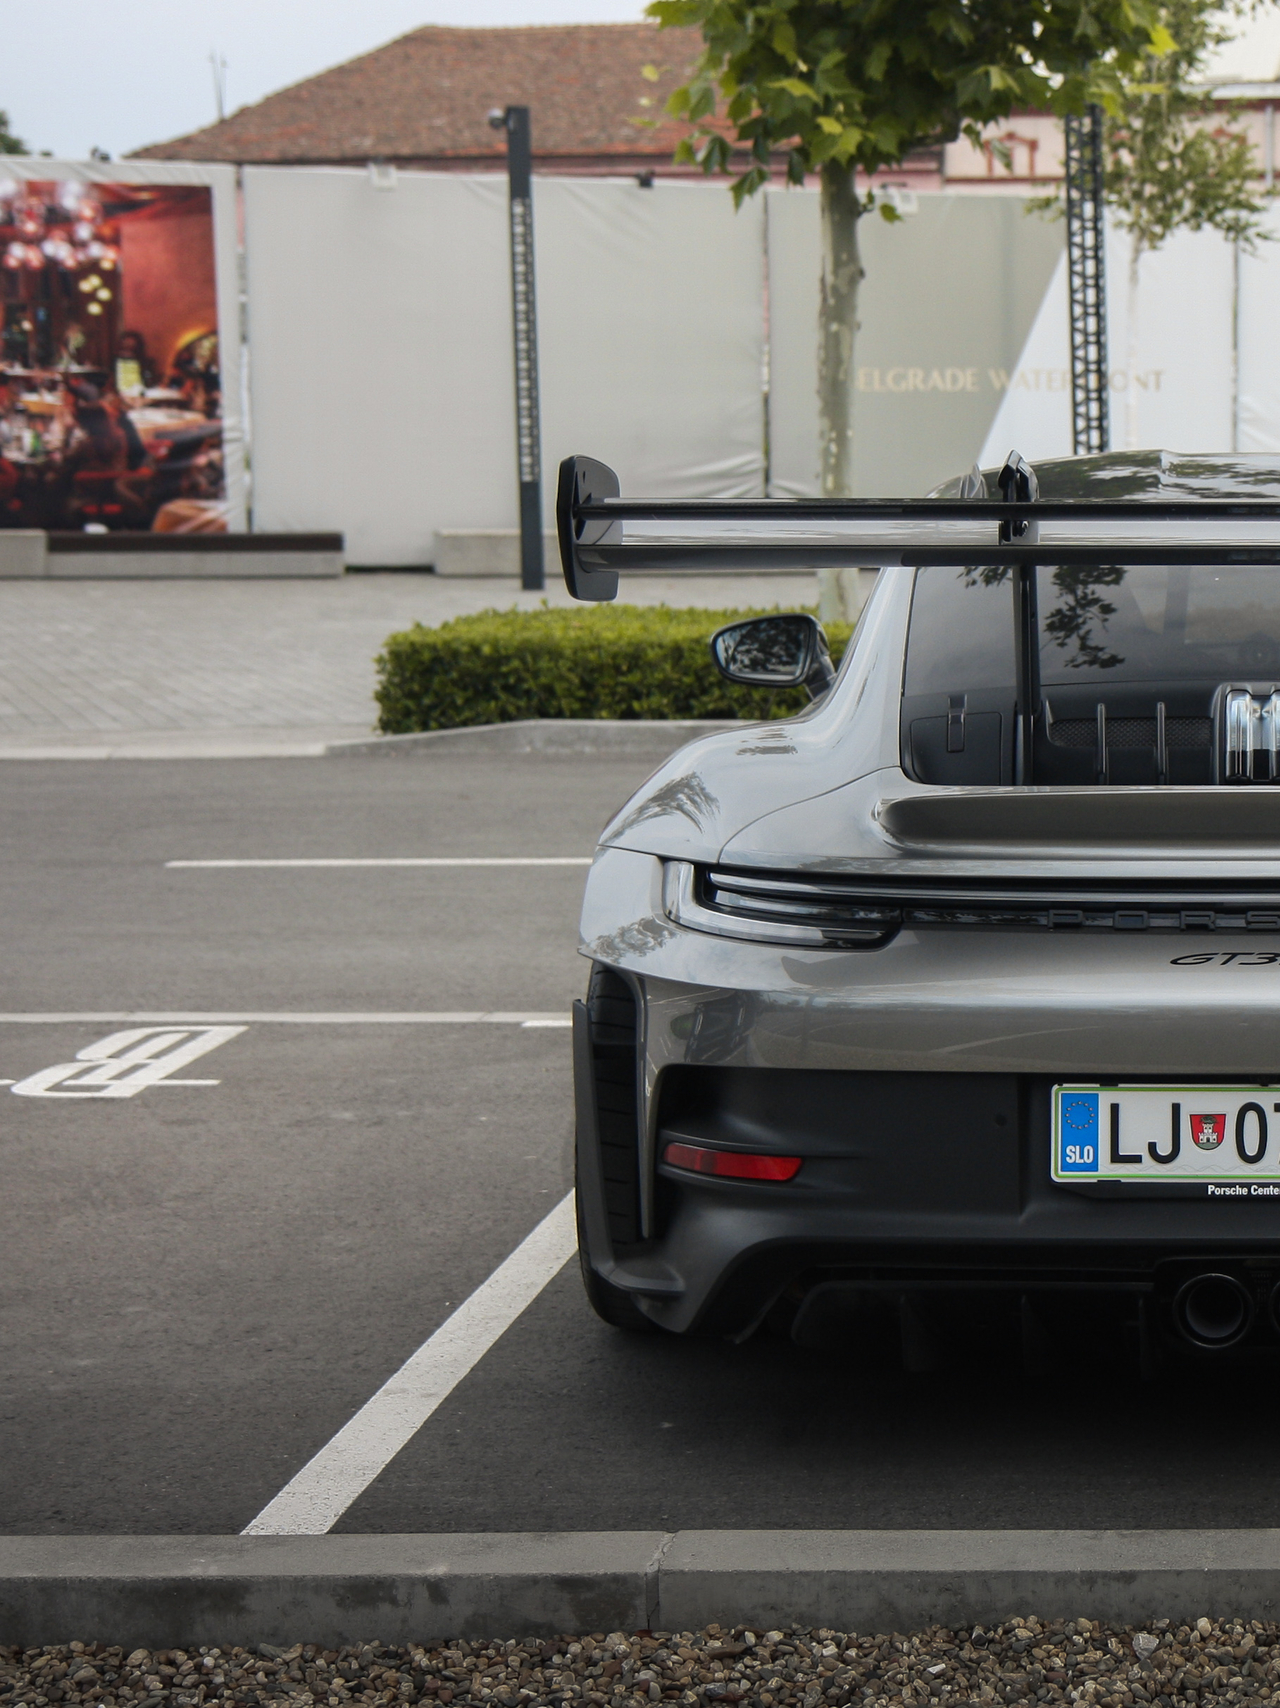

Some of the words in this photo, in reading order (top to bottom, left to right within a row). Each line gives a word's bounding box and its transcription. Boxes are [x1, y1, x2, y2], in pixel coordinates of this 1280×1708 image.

[858, 367, 980, 393] ELGRADE
[1109, 1102, 1181, 1165] LJ
[1065, 1145, 1094, 1164] SLO
[1207, 1184, 1248, 1195] Porsche
